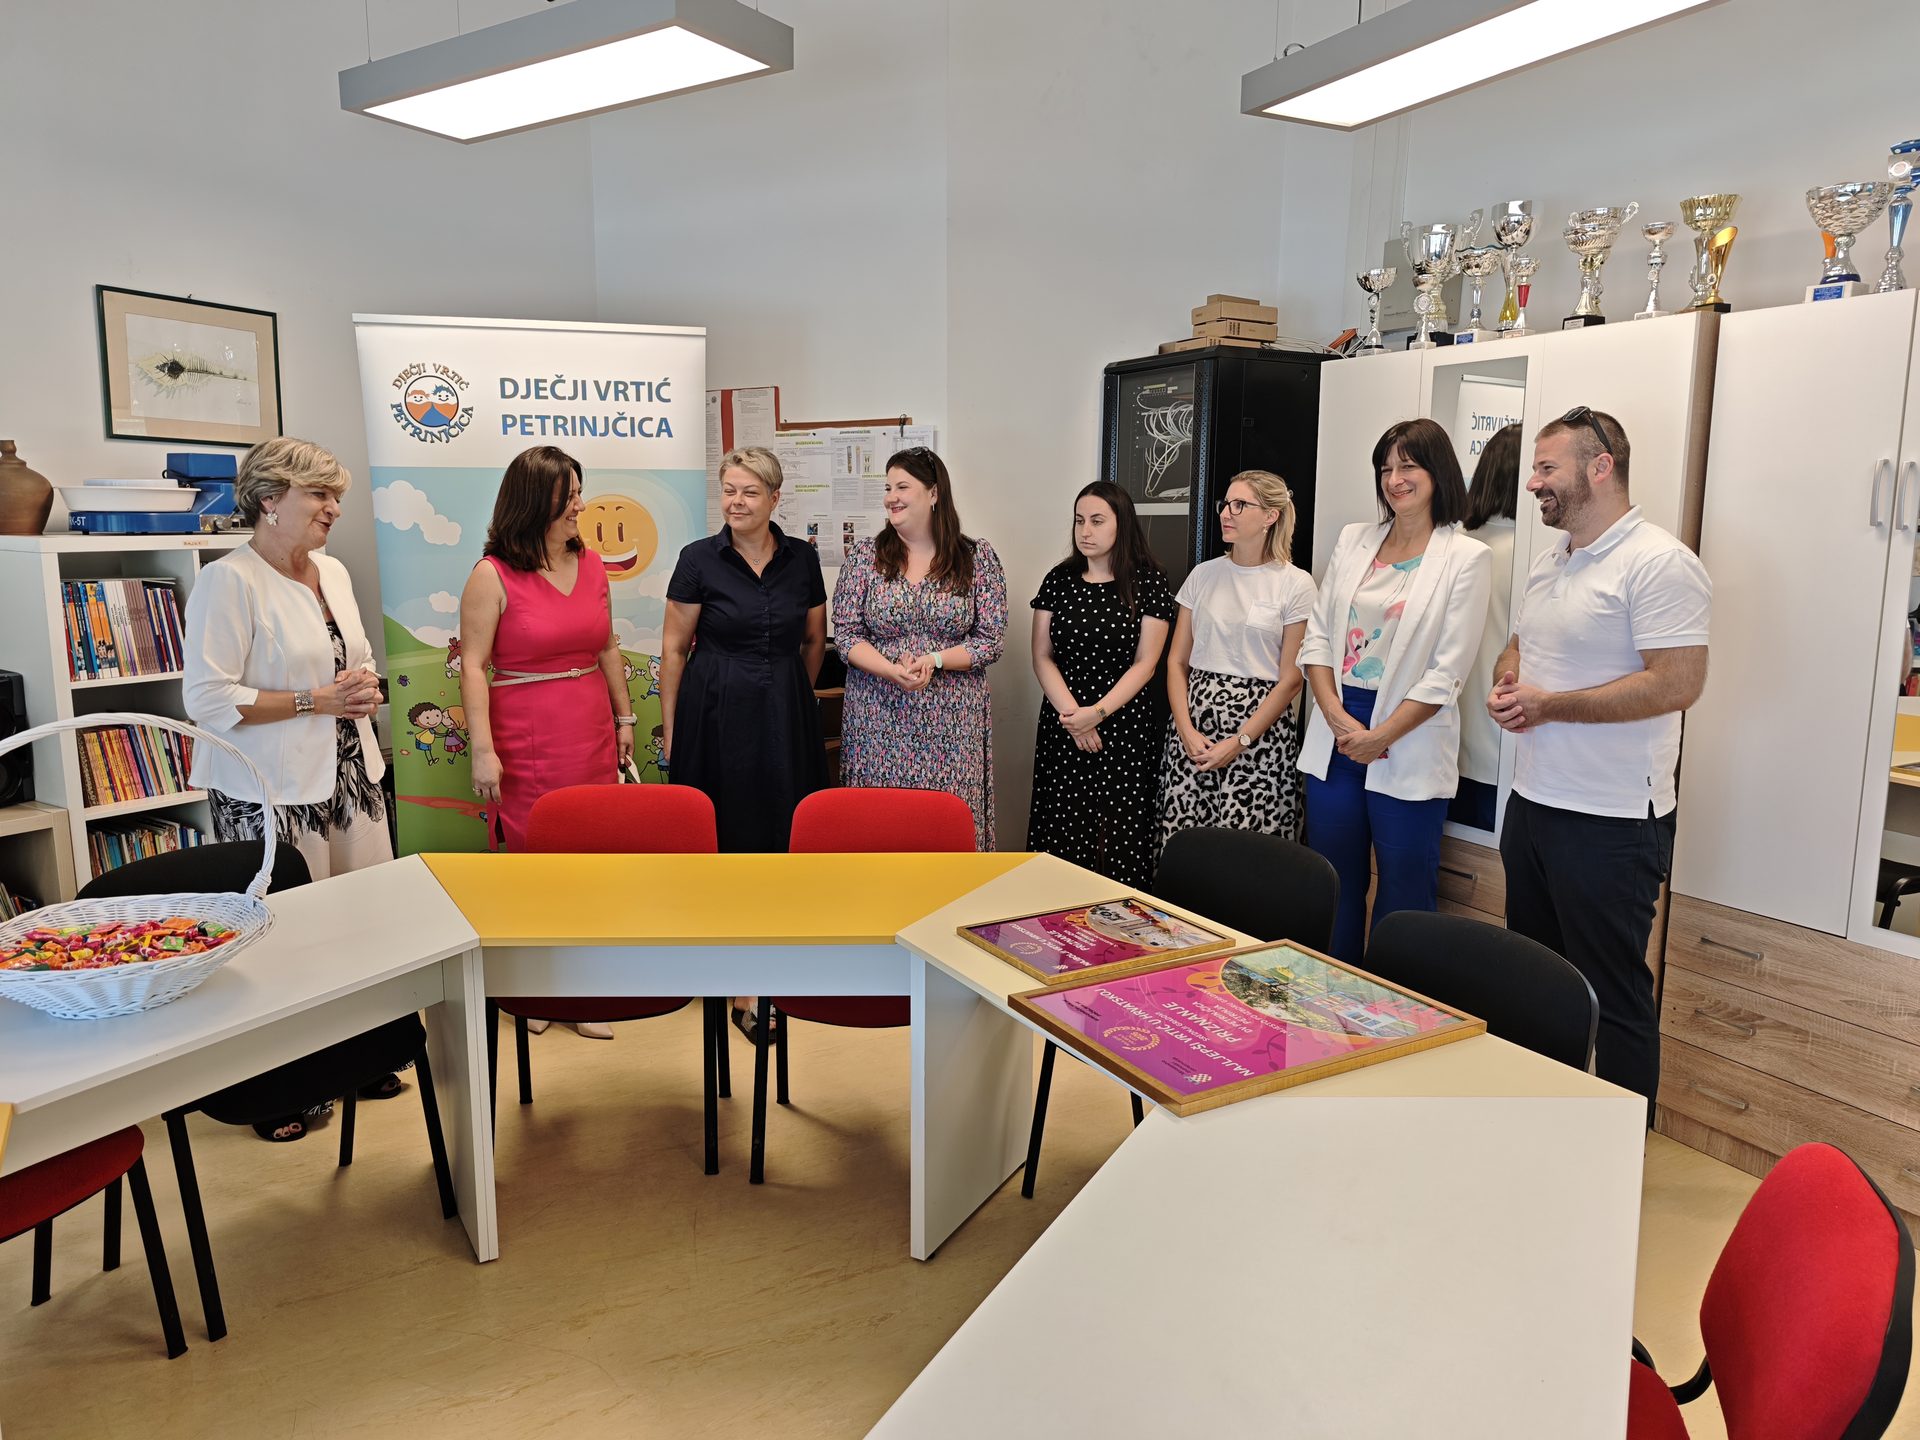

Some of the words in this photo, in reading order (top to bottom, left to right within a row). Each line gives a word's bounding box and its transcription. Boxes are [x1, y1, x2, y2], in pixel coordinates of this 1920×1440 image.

[392, 363, 427, 390] DJEČJI
[432, 363, 470, 391] VRTIĆ
[499, 374, 588, 402] DJEČJI
[593, 377, 672, 403] VRTIĆ
[501, 411, 674, 439] PETRINJČICA
[1093, 987, 1154, 1020] HRVATSKOJ
[1158, 1023, 1195, 1043] VRTIĆ
[1161, 1000, 1244, 1043] PRIZNANJE
[1188, 1041, 1255, 1077] NAJLJEPŠI
